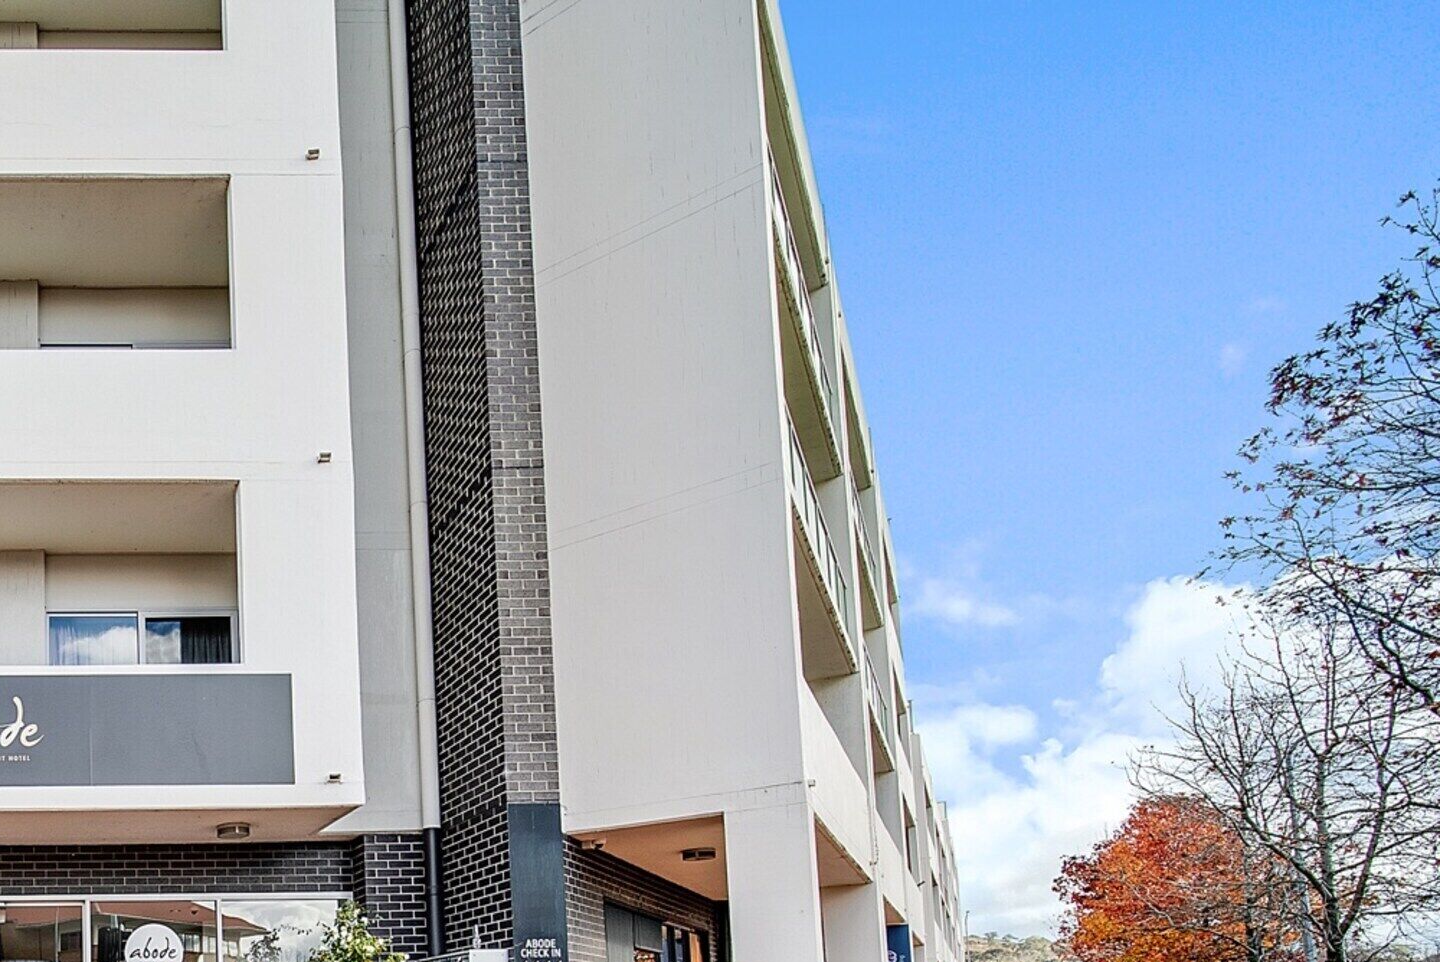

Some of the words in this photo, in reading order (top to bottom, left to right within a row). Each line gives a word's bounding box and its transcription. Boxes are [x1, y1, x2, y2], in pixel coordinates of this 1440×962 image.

[129, 936, 178, 959] abode
[525, 938, 557, 949] ABODE
[520, 948, 550, 958] CHECK
[550, 948, 561, 958] IN
